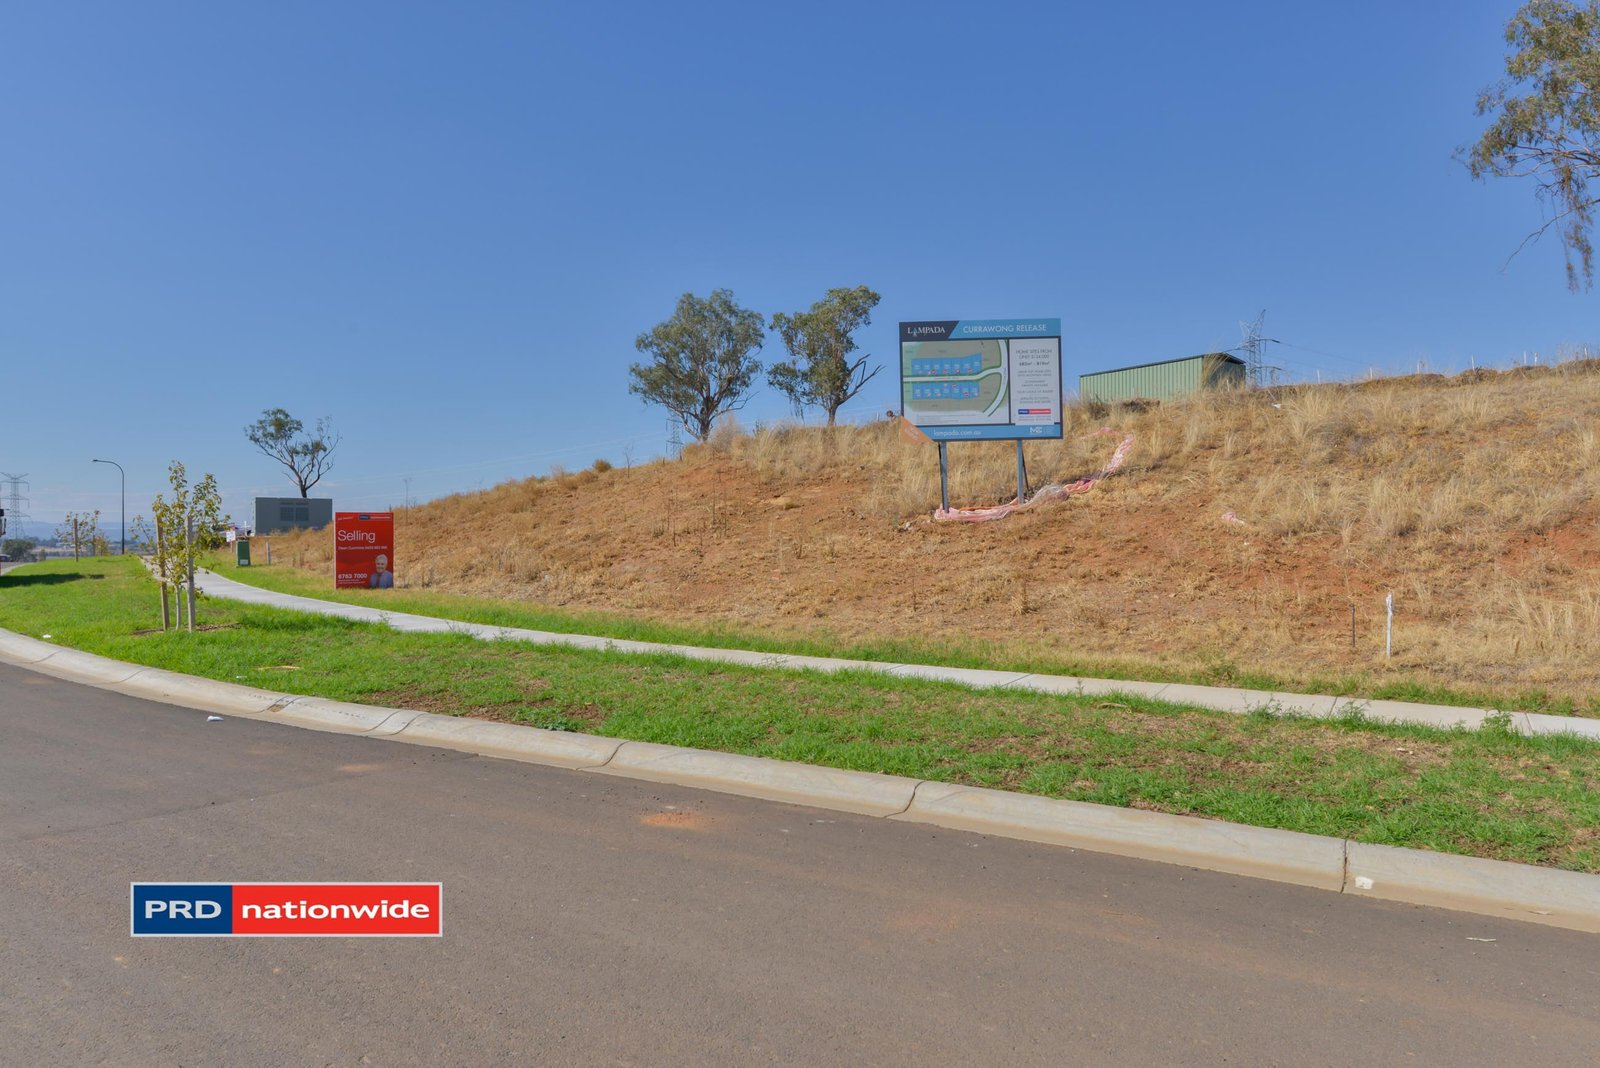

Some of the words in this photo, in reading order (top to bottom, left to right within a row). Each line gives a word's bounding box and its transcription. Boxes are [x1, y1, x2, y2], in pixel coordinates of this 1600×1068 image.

[907, 326, 946, 335] LAMPADA
[963, 325, 1014, 333] CURRAWONG
[1016, 324, 1047, 332] RELEASE
[934, 428, 981, 437] lampada.com.au
[337, 530, 376, 543] Selling
